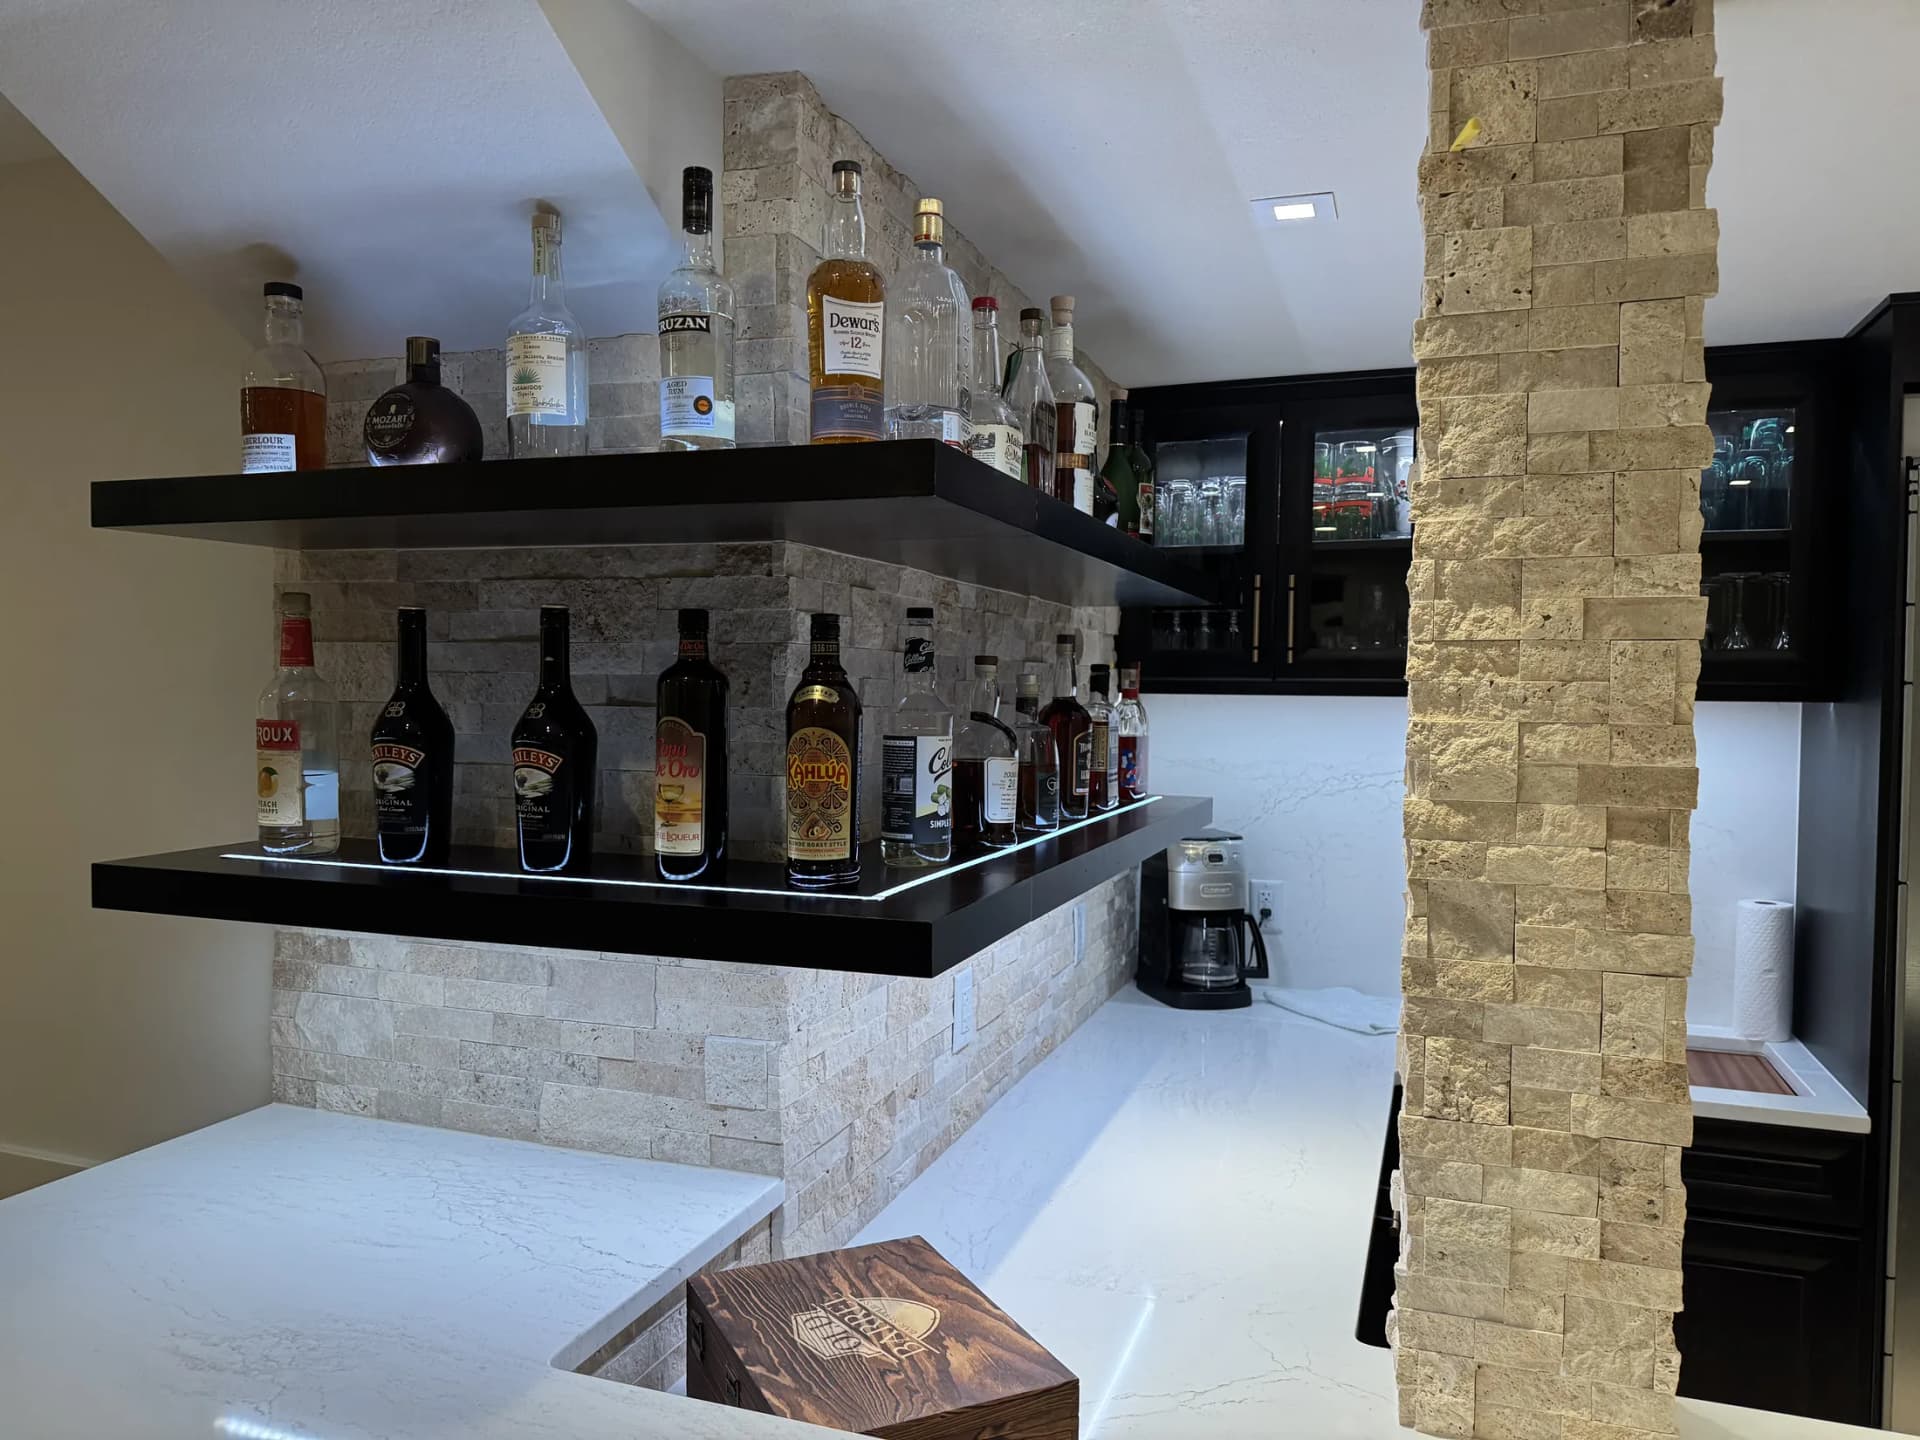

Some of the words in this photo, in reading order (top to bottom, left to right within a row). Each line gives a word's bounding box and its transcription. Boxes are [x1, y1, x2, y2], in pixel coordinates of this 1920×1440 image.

[657, 317, 707, 333] RUZAN
[829, 312, 880, 333] Dewar's
[850, 336, 862, 349] 12
[666, 380, 687, 389] AGED
[371, 414, 408, 424] MOZART
[371, 746, 417, 762] AILEYS
[669, 760, 700, 778] Oro
[787, 754, 849, 790] KAHLÚA
[803, 1315, 862, 1351] OLD
[820, 1292, 929, 1358] BARREL
